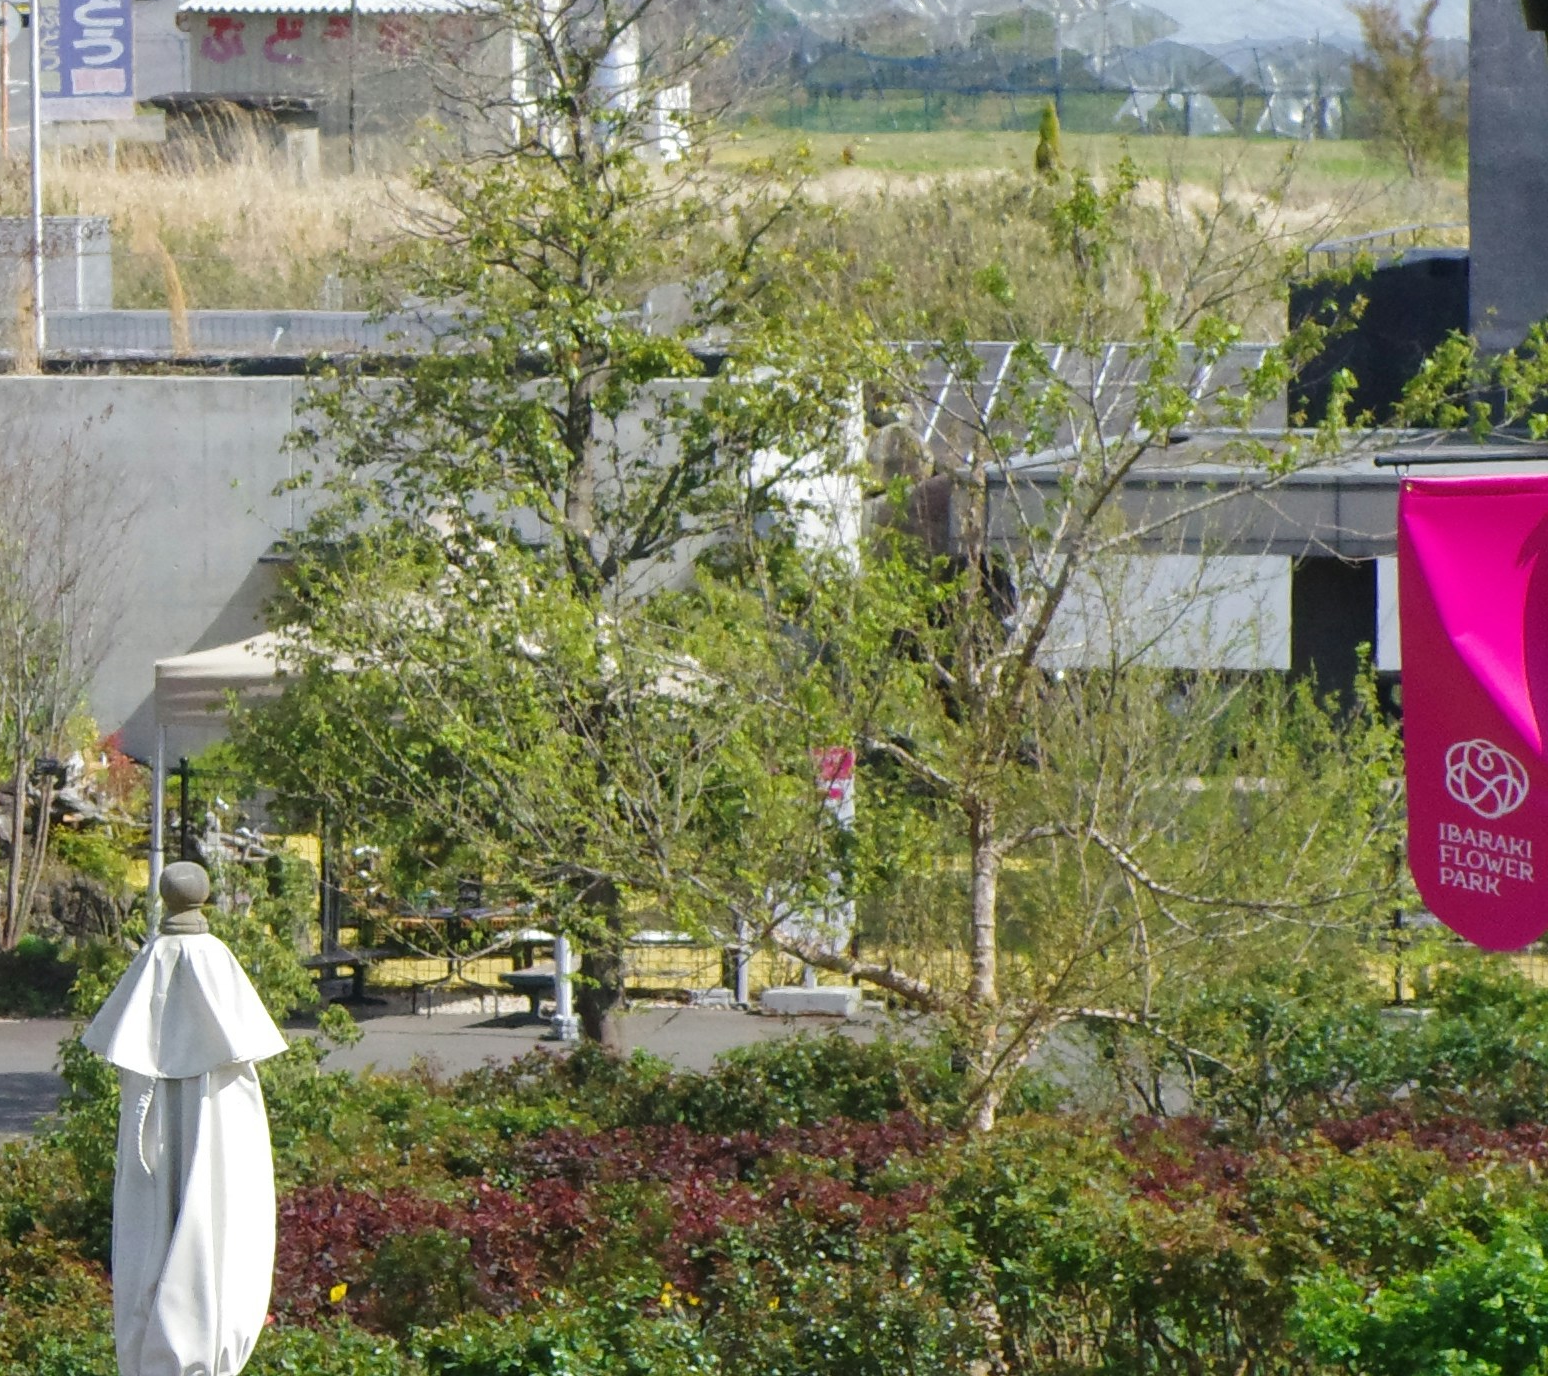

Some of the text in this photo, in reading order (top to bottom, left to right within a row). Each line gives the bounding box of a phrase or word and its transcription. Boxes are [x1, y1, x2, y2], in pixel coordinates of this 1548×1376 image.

[1439, 822, 1532, 859] IBARAKI
[1439, 844, 1534, 883] FLOWER
[1439, 867, 1501, 897] PARK
